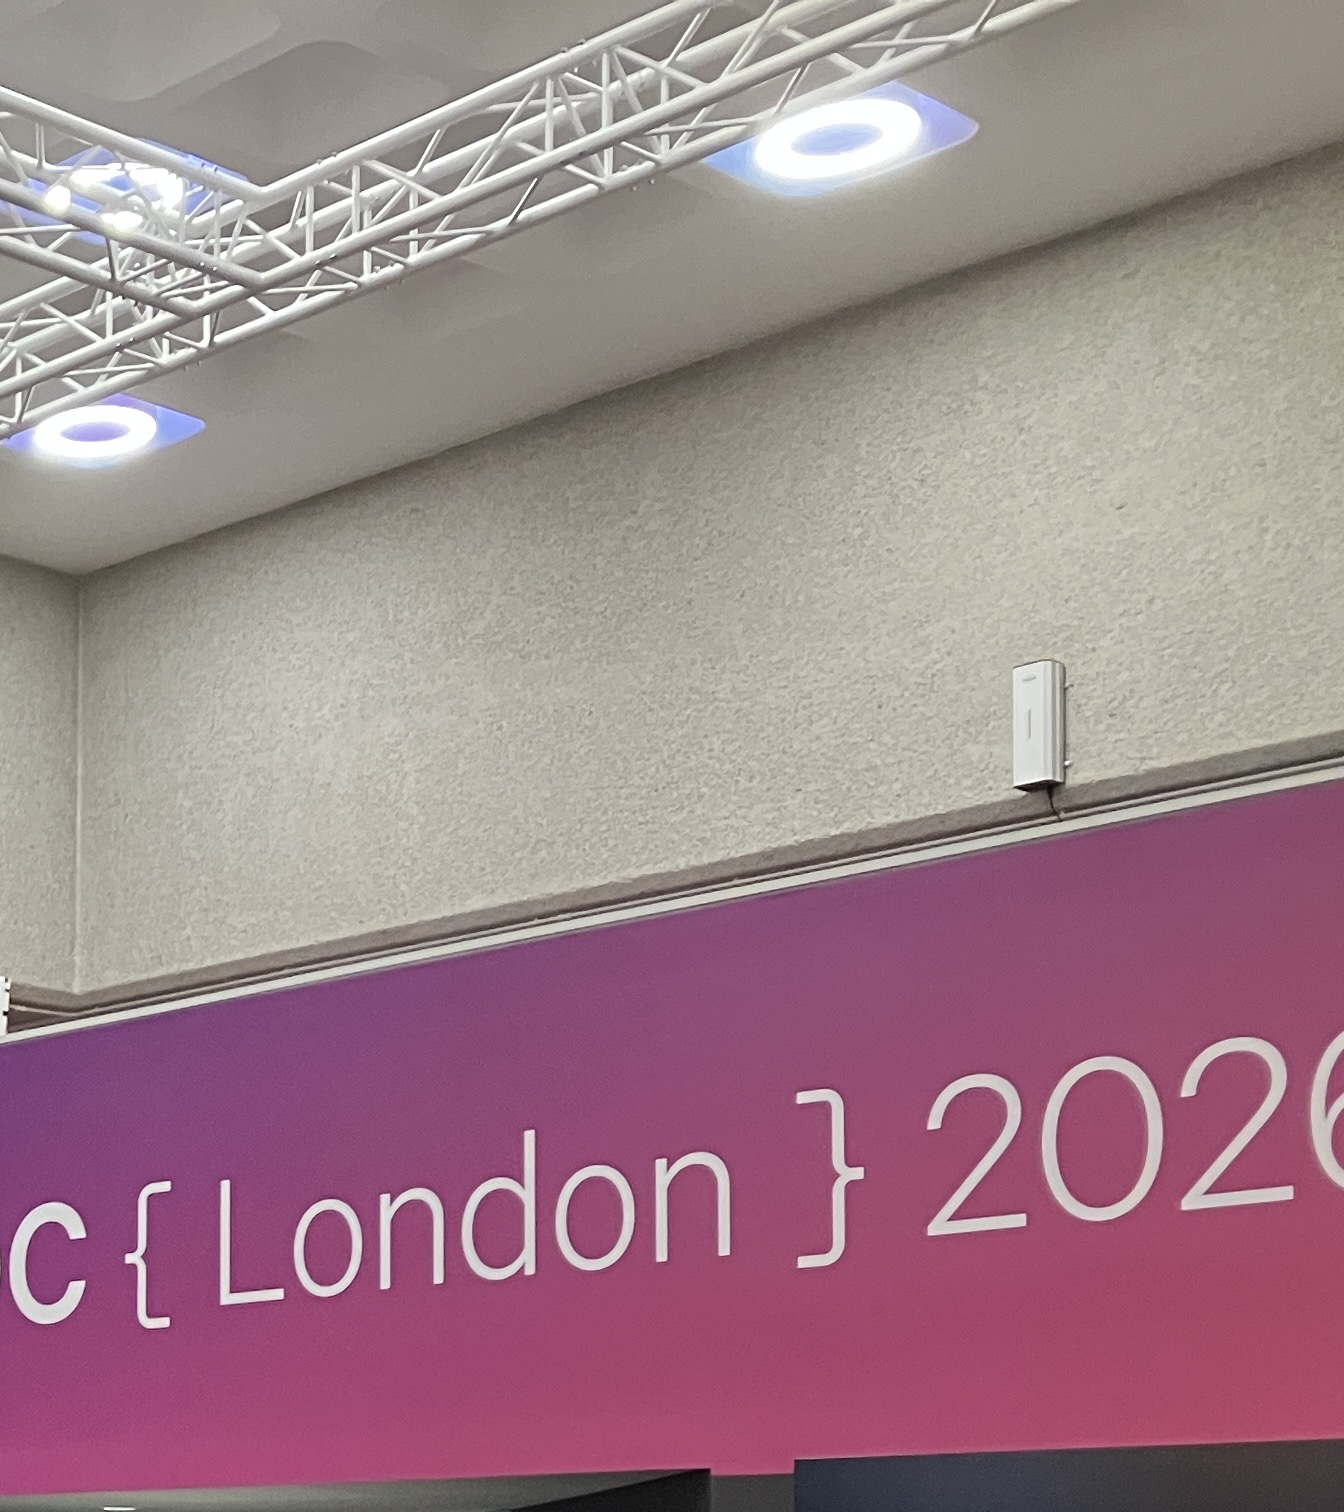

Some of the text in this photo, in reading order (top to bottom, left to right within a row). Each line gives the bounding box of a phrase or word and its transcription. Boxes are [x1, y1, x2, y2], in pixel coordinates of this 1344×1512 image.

[125, 1181, 171, 1328] {
[220, 1130, 730, 1305] London
[796, 1089, 864, 1268] }
